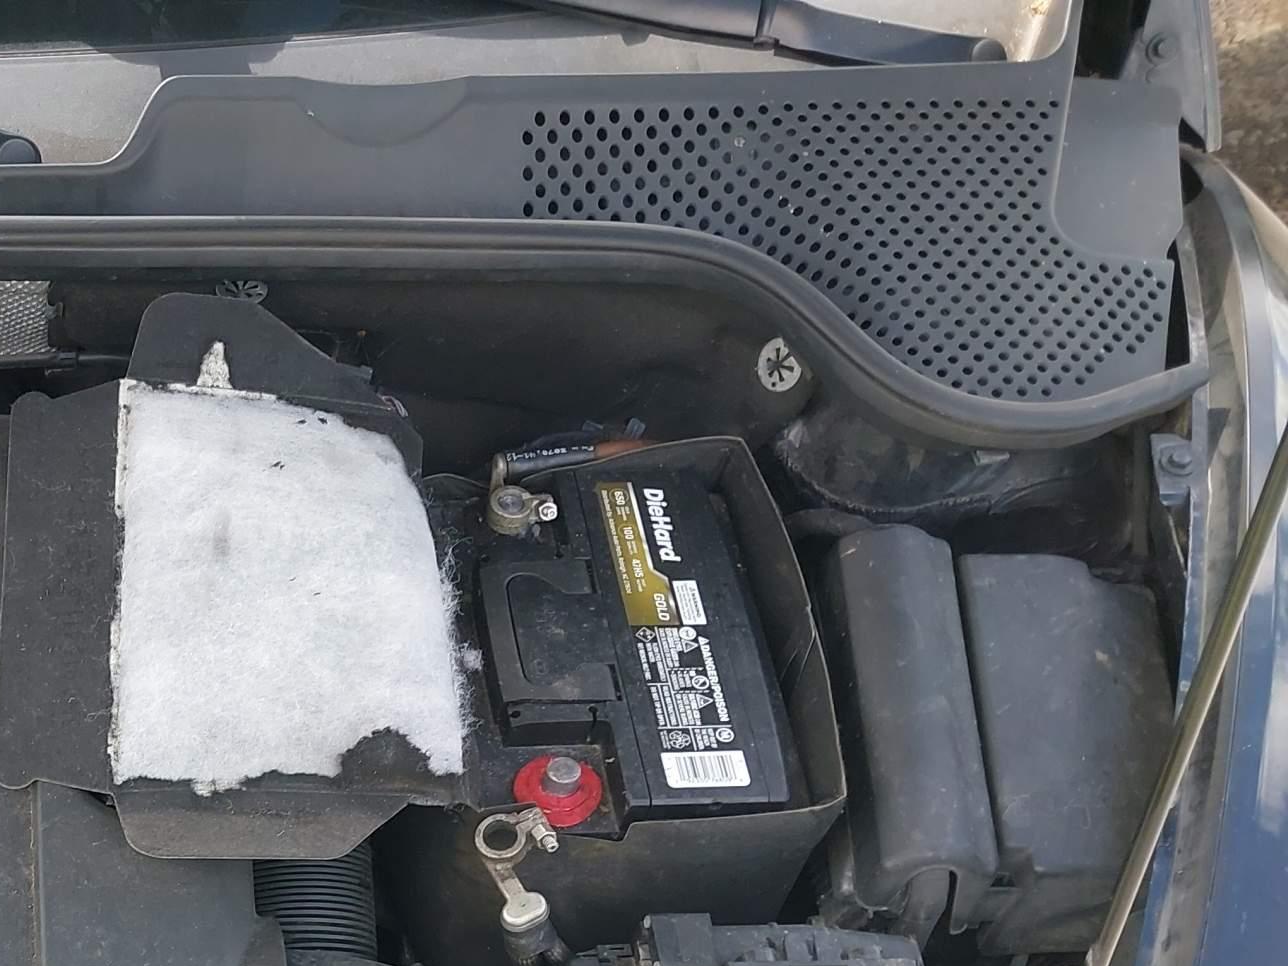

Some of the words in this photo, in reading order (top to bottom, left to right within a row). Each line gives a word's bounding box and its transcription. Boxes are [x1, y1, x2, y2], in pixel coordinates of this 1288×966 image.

[622, 527, 634, 539] 100
[642, 488, 681, 561] DieHard
[652, 593, 670, 621] GOLD
[700, 644, 729, 720] DANGER/POISON
